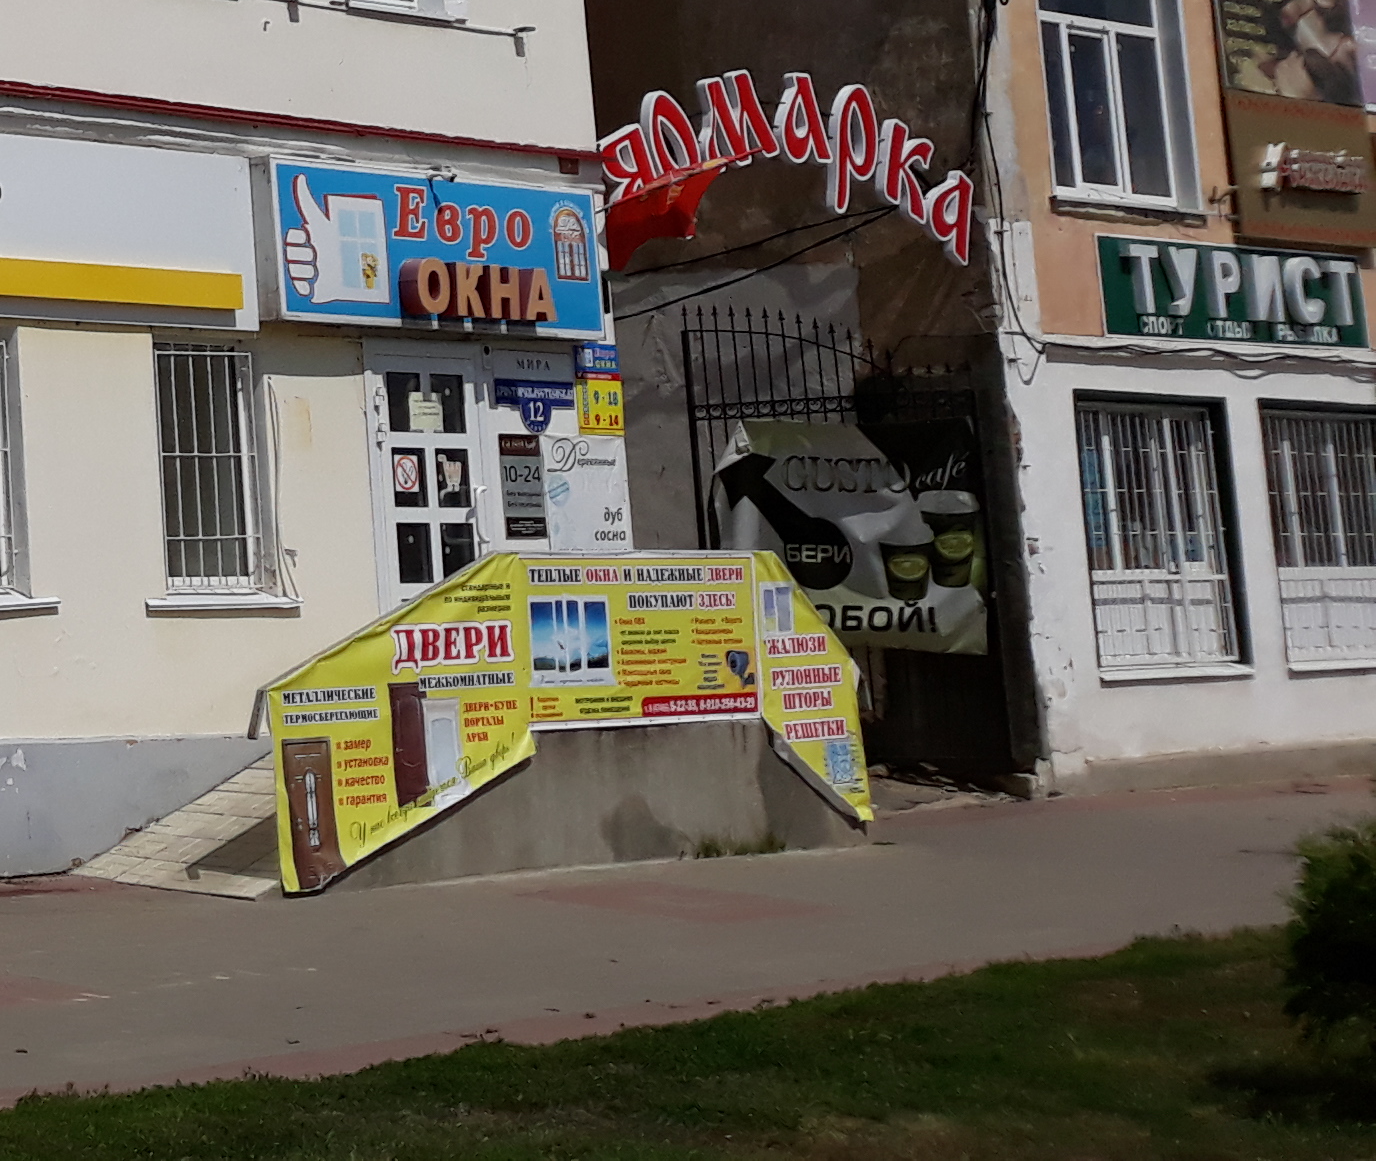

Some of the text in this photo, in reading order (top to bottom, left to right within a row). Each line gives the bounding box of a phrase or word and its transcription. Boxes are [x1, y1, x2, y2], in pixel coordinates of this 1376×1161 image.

[393, 184, 533, 261] Евро
[416, 257, 557, 322] ОКНА
[1128, 243, 1356, 326] ТУРИСТ
[517, 358, 550, 371] МИРА
[529, 401, 544, 421] 12
[504, 465, 541, 482] 10-24
[604, 507, 623, 526] дуб
[594, 530, 626, 541] сосна
[787, 544, 851, 563] БЕРИ
[529, 567, 743, 583] ТЕПЛЫЕ ОКНА И НАДЕЖНЫЕ ДВЕРИ
[628, 594, 694, 609] ПОКУПАЮТ
[394, 625, 511, 671] ДВЕРИ
[768, 636, 826, 655] ЖАЛЮЗИ
[419, 671, 514, 689] МЕЖКОМНАТНЫЕ
[772, 667, 840, 686] РУЛОННЫЕ
[283, 687, 376, 704] МЕТАЛЛИЧЕСКИЕ
[783, 691, 832, 710] ШТОРЫ
[284, 709, 378, 724] ТЕРМОСБЕРЕГАЮЩИЕ
[784, 720, 845, 740] РЕШЕТКИ
[344, 739, 371, 751] замер
[344, 756, 389, 771] установка
[344, 775, 385, 787] качество
[346, 794, 387, 808] гарантия
